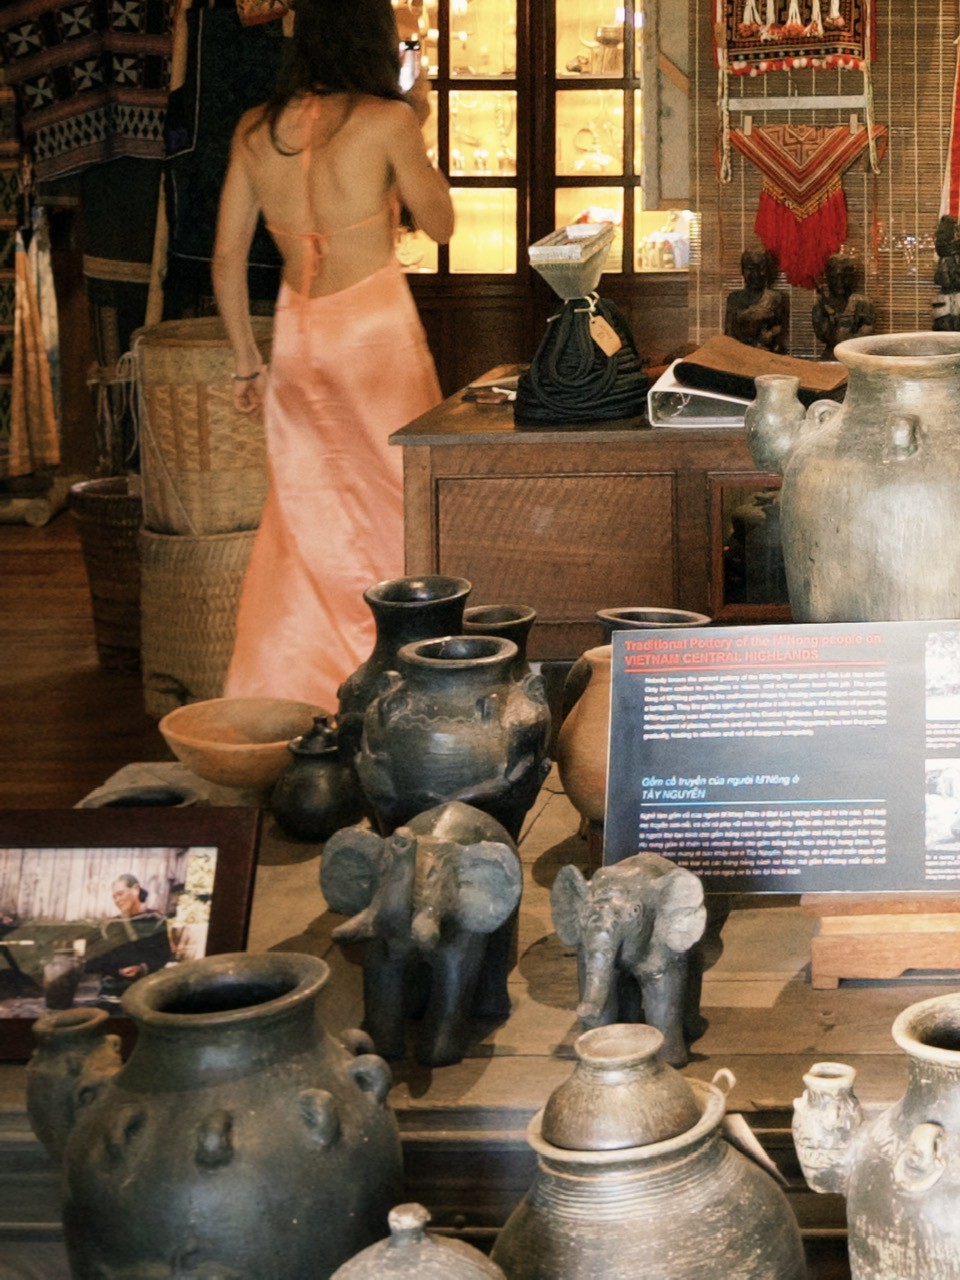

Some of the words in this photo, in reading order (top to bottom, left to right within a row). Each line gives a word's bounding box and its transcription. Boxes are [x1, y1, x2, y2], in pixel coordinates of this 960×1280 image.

[625, 639, 687, 651] Traditional
[689, 637, 732, 649] Pottery
[736, 636, 749, 648] of
[751, 635, 769, 646] the
[822, 633, 862, 646] people
[866, 634, 881, 644] on
[624, 653, 680, 666] VIETNAM
[683, 651, 741, 664] CENTRAL
[745, 649, 819, 662] HIGHLANDS
[642, 788, 661, 799] TÂY
[662, 787, 706, 800] NGUYÊN
